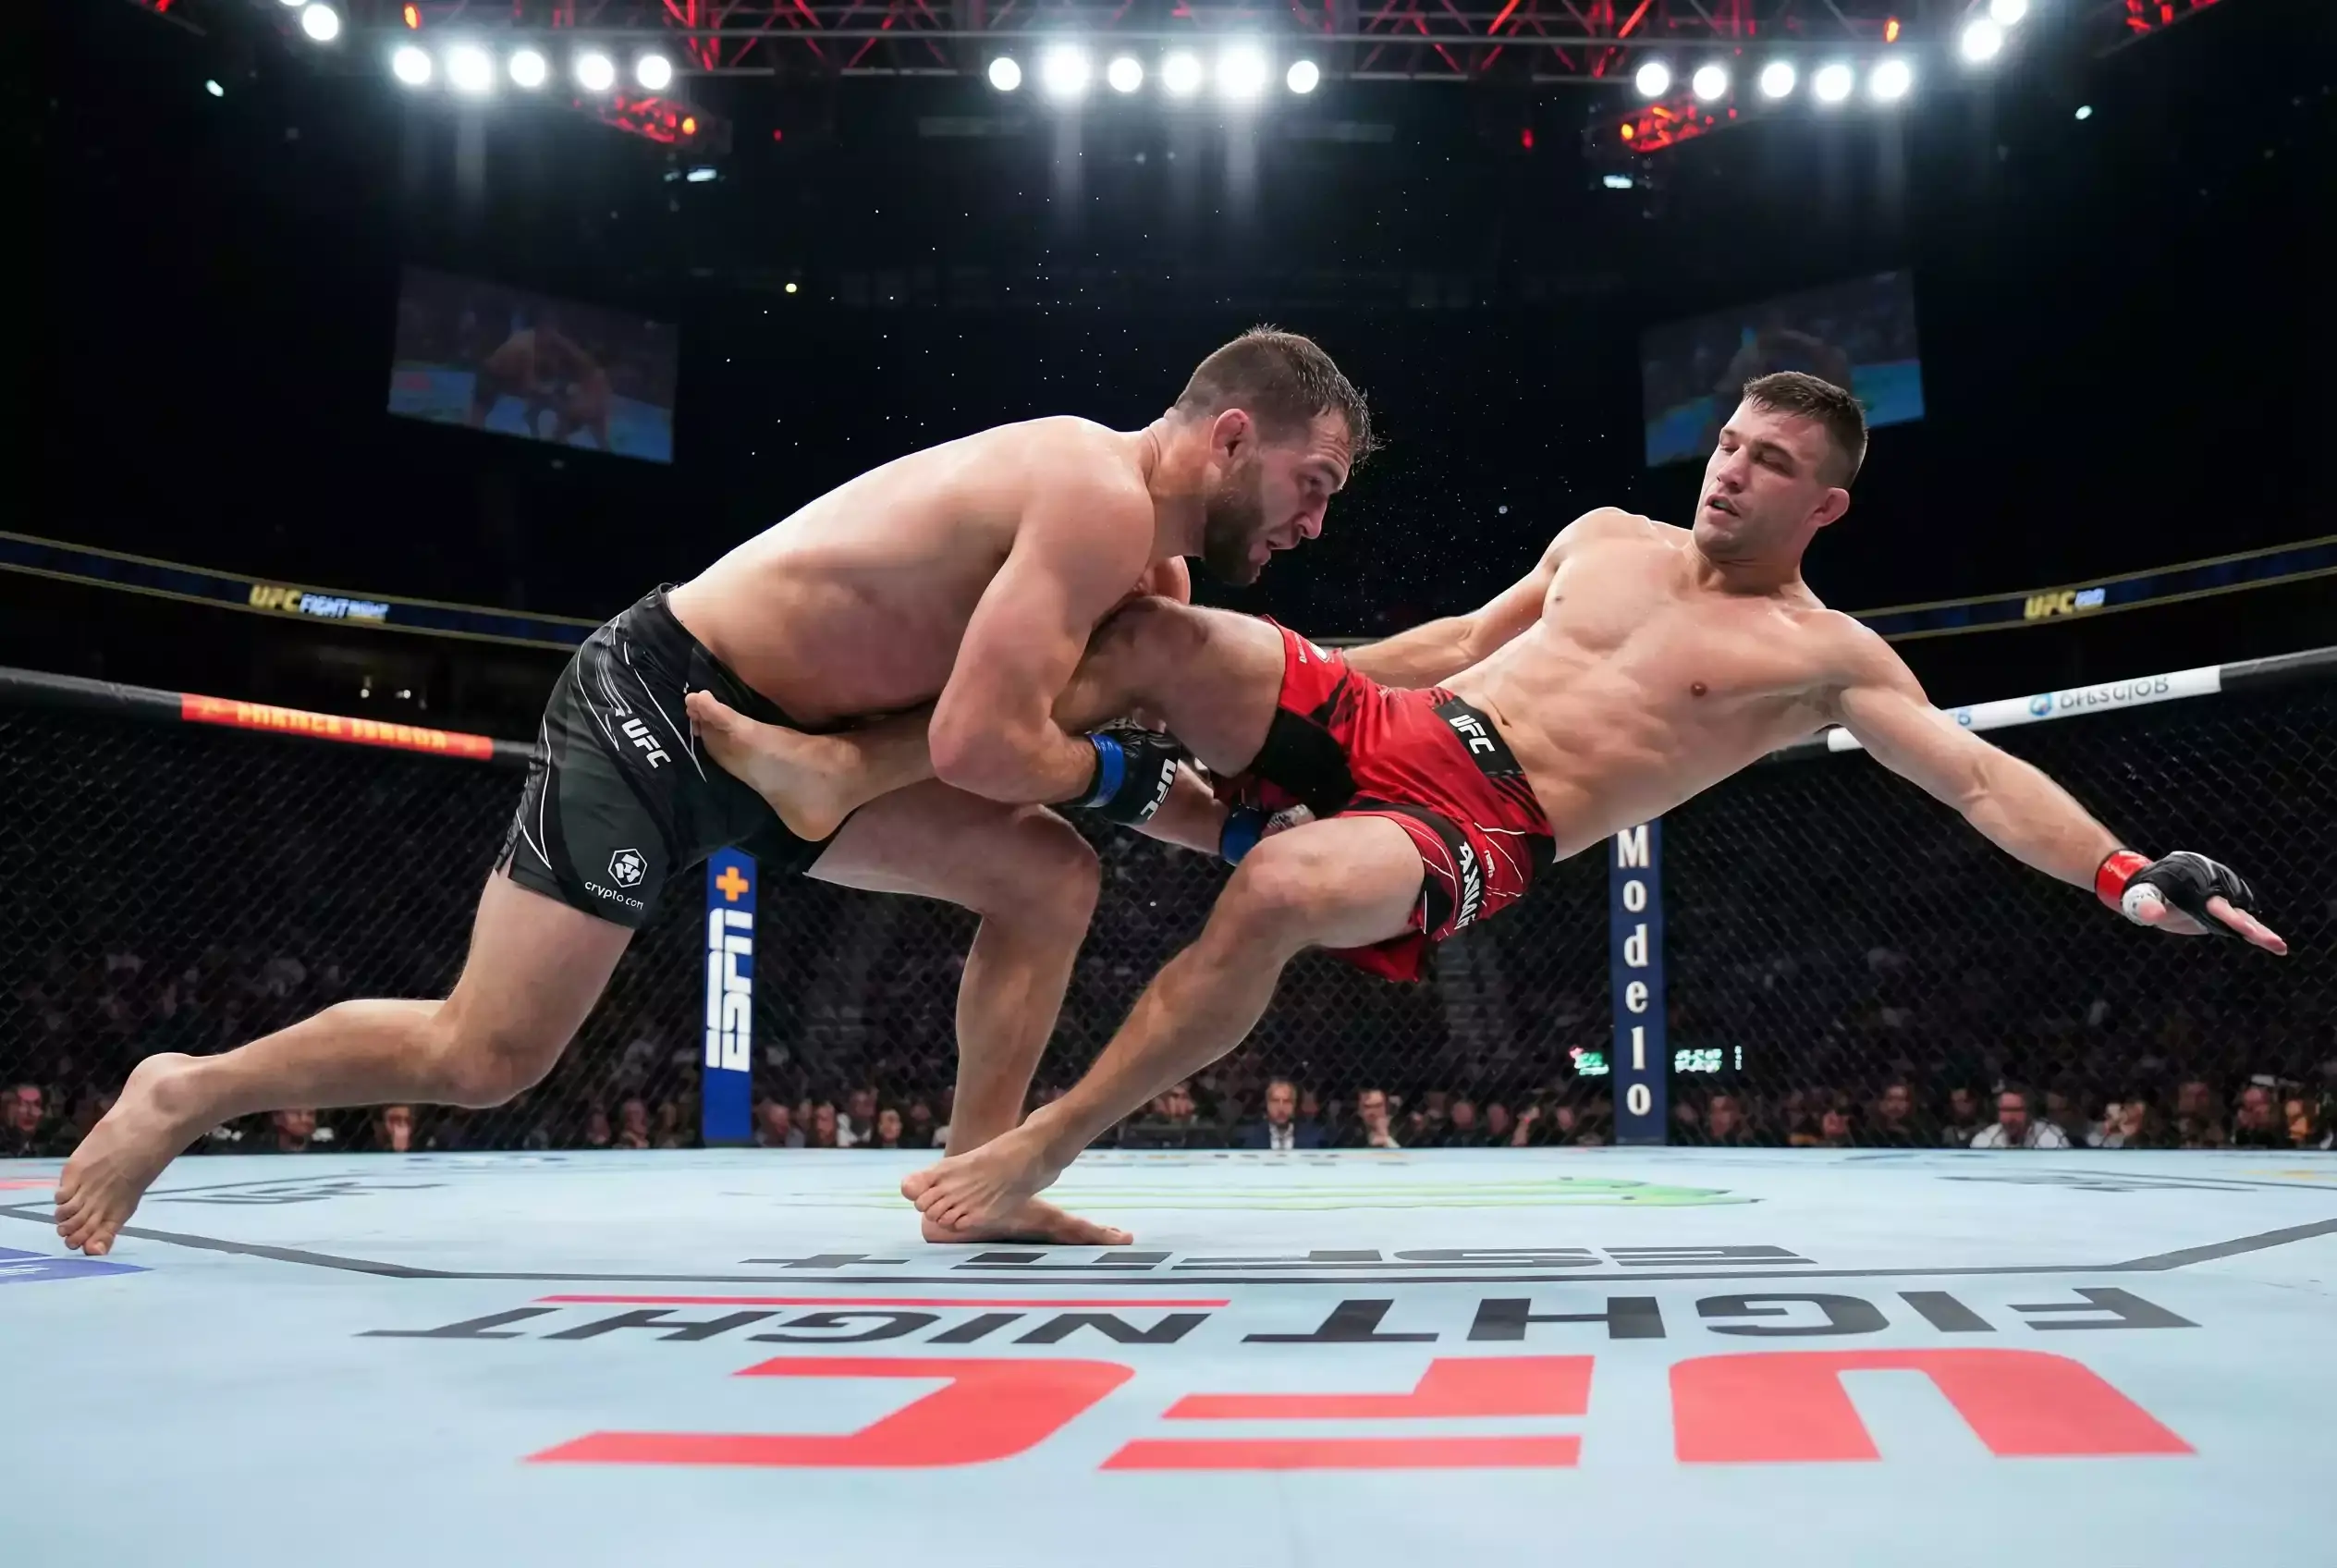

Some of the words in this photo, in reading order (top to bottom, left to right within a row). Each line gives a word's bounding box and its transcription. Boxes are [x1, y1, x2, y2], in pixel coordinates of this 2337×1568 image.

[249, 584, 302, 612] UFC
[2024, 590, 2076, 619] UFC
[621, 717, 672, 769] UFC
[1449, 713, 1496, 754] UFC
[1140, 758, 1177, 822] UFC
[1617, 824, 1652, 1117] Modelo
[361, 1306, 1213, 1344] NIGHT
[1242, 1286, 2199, 1343] FIGHT
[525, 1347, 2195, 1470] UFC
